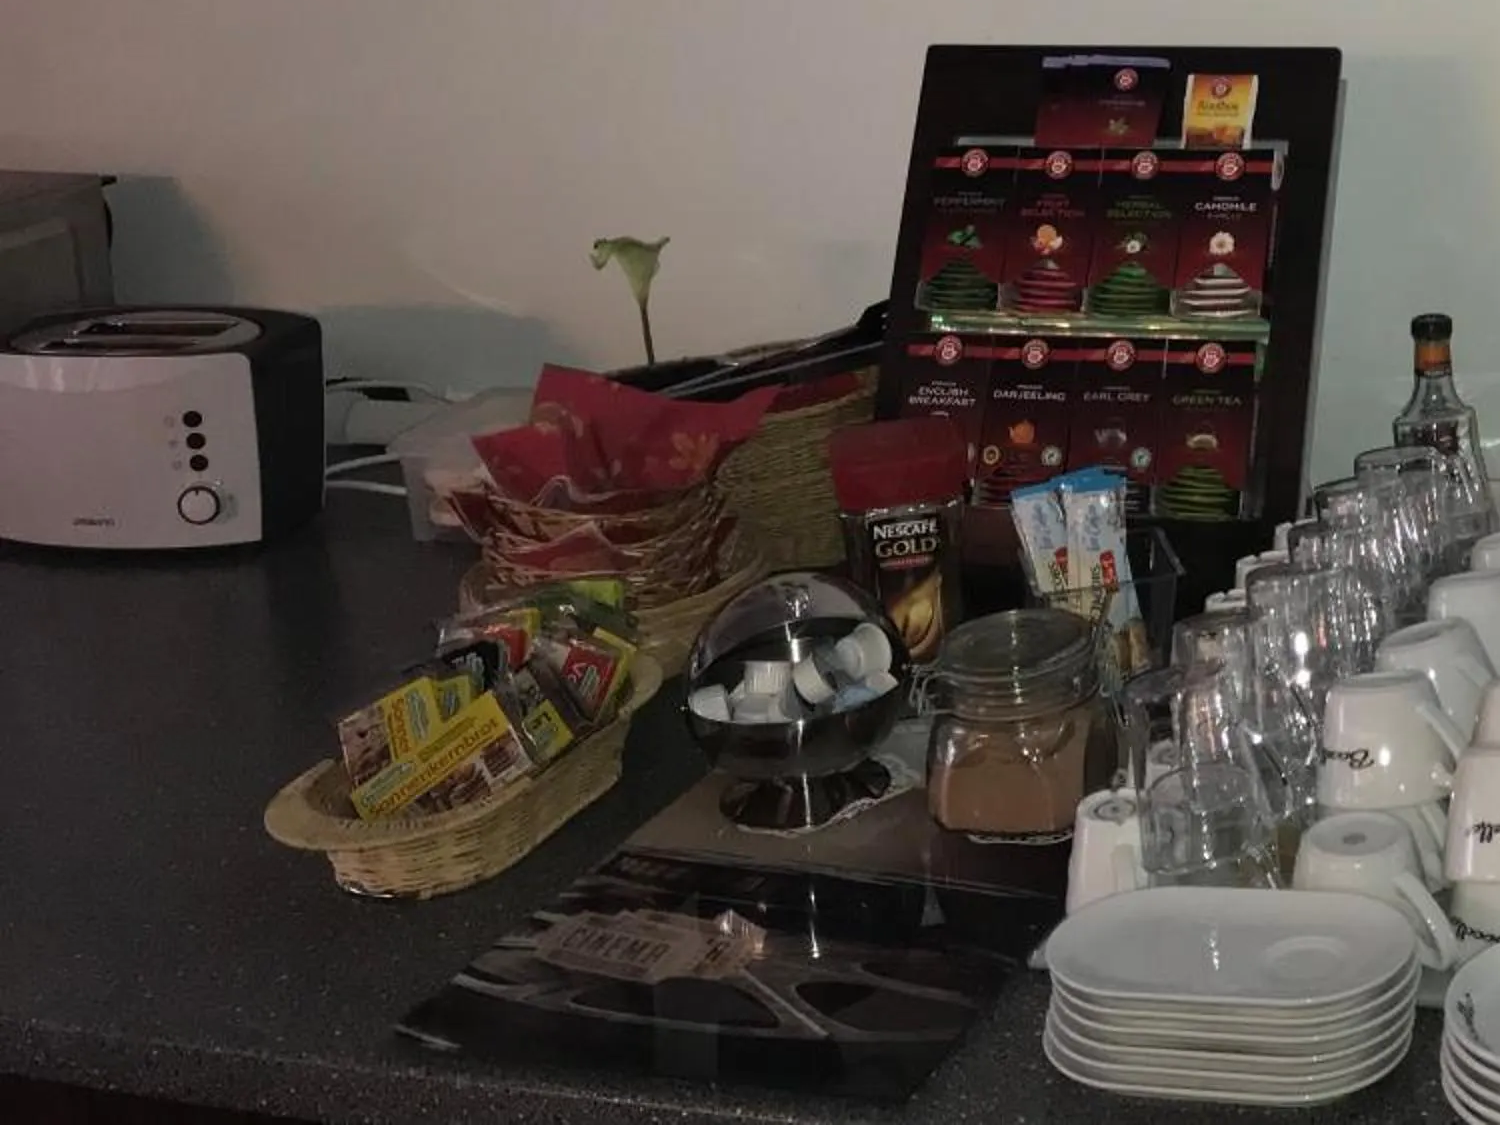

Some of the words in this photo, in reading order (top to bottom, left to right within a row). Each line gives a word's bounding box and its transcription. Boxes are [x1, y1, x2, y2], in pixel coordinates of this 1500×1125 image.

[993, 388, 1066, 402] DARJEELING
[876, 537, 937, 559] GOLD
[562, 927, 672, 965] CINEMA
